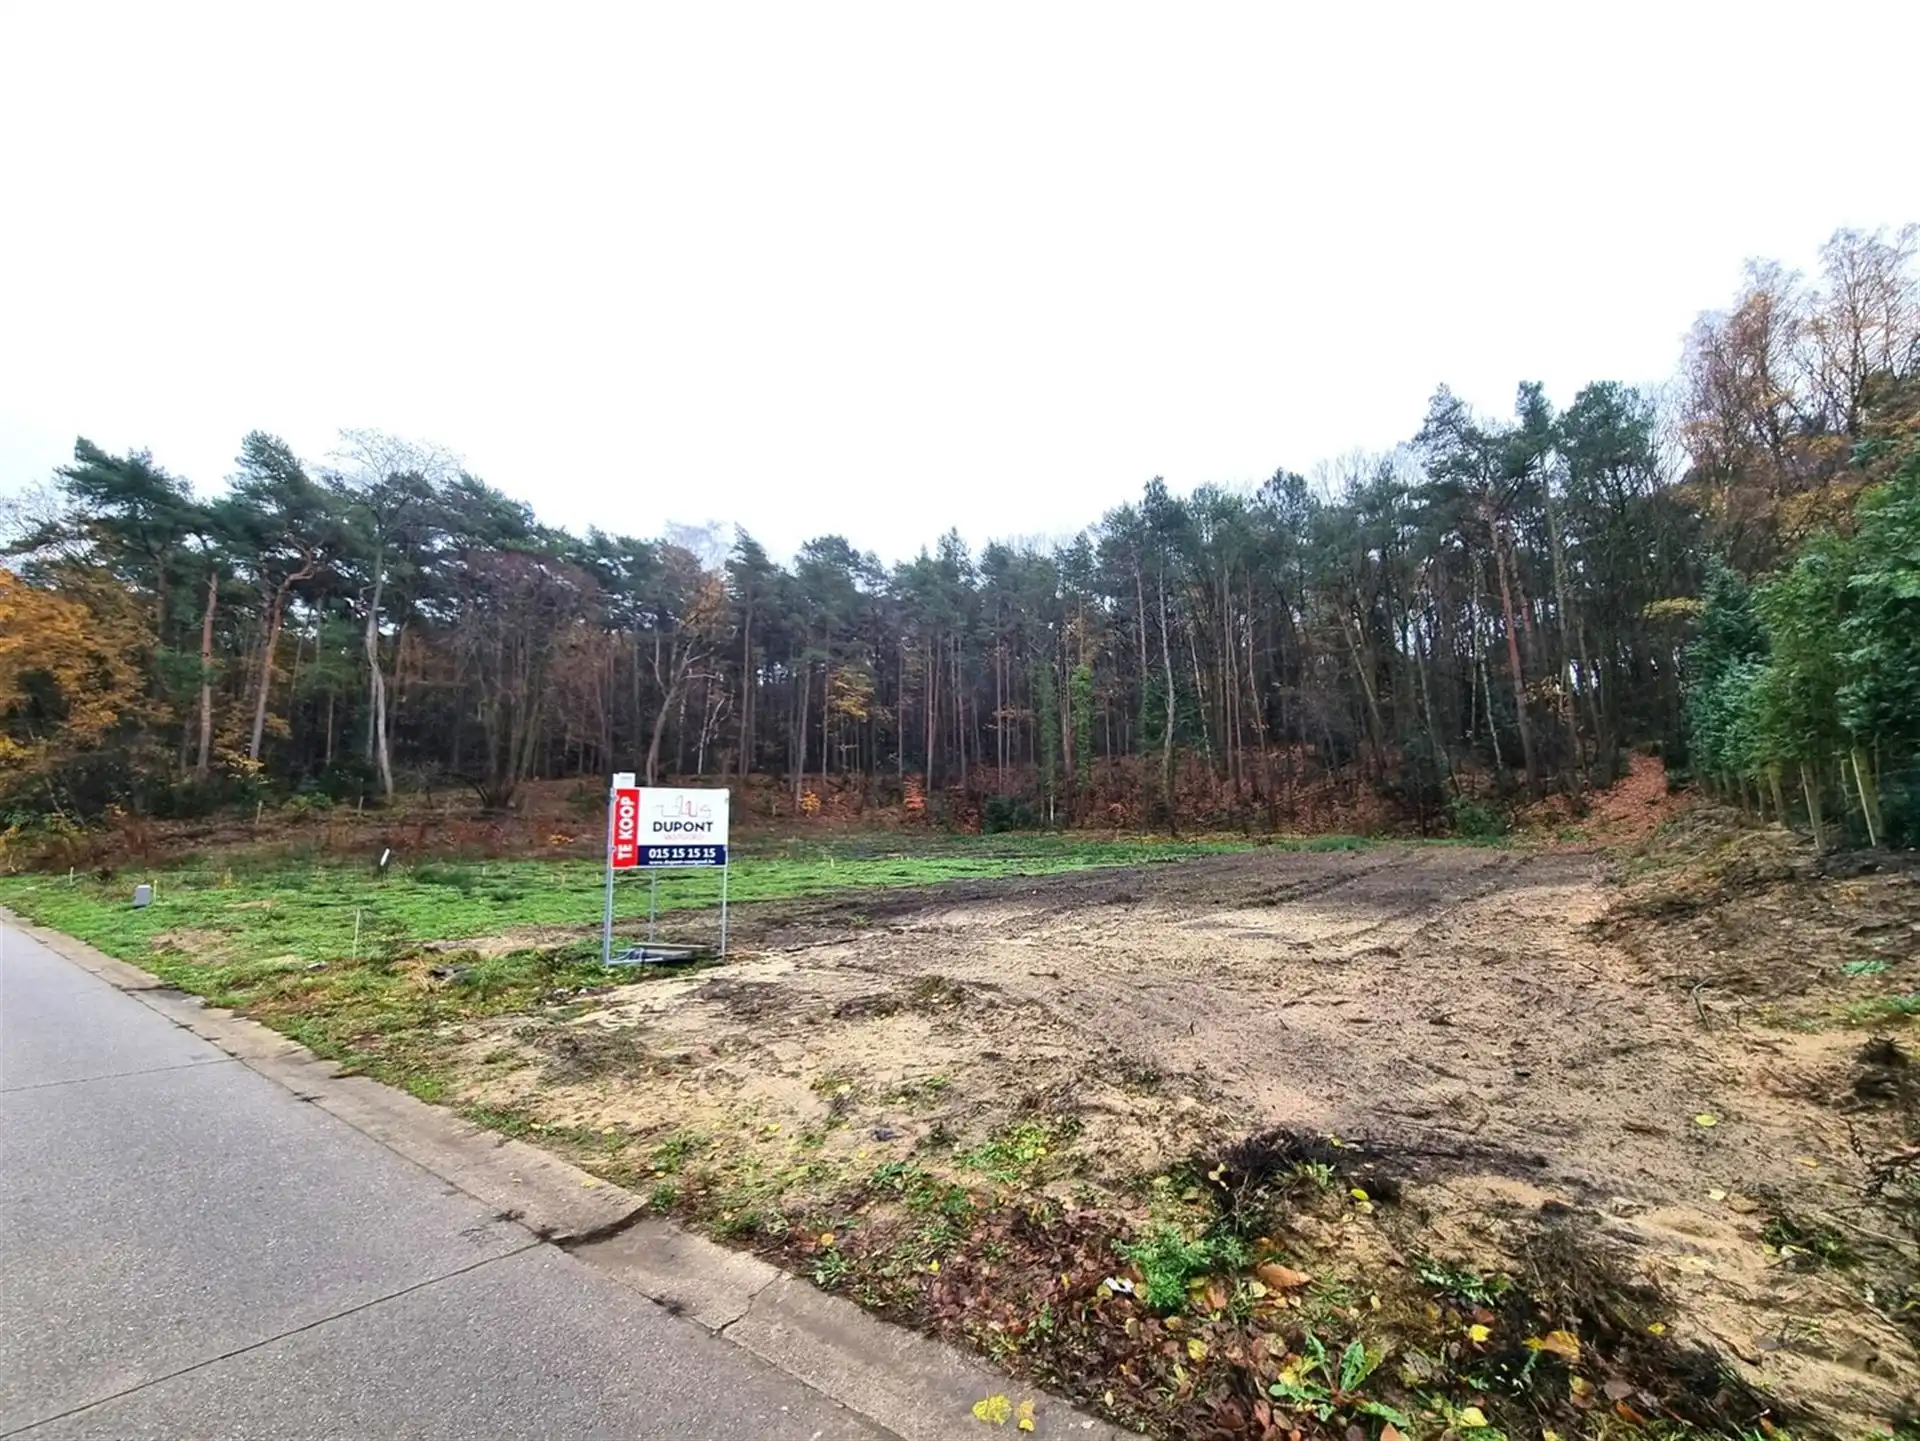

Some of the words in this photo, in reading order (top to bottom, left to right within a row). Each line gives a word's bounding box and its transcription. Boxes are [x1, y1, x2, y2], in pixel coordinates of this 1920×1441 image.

[618, 796, 635, 840] KOOP
[653, 821, 714, 832] DUPONT
[617, 843, 633, 860] TE
[648, 848, 669, 859] 015
[672, 848, 685, 858] 15
[687, 848, 701, 858] 15
[703, 848, 716, 858] 15
